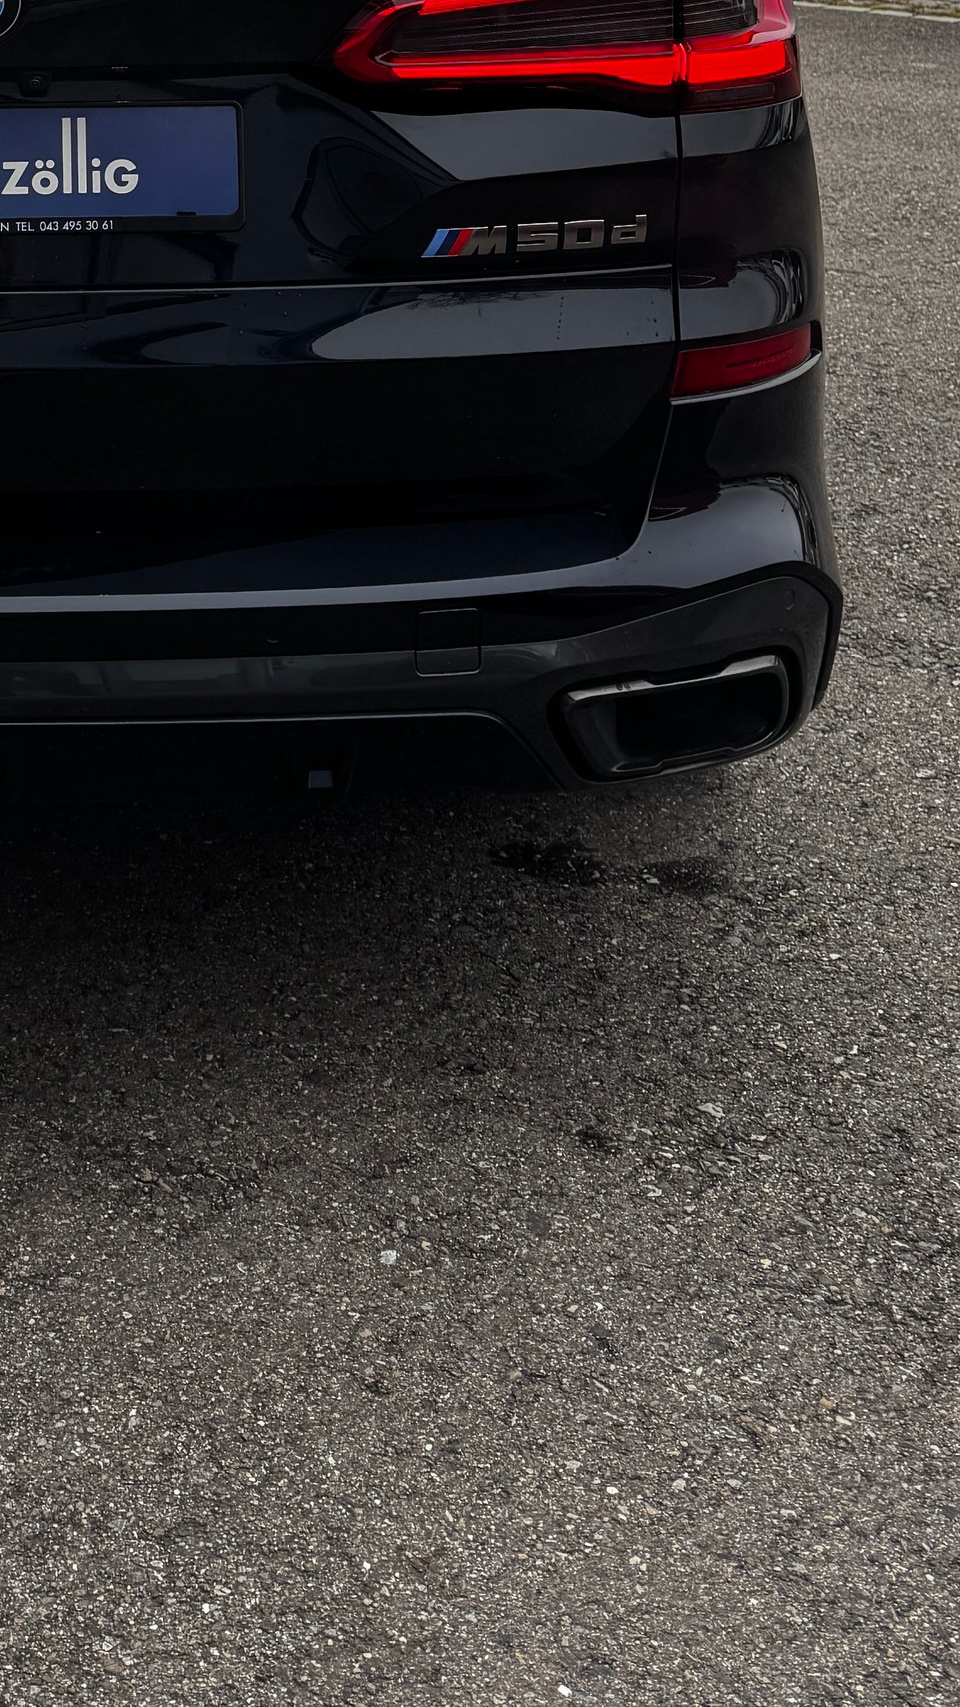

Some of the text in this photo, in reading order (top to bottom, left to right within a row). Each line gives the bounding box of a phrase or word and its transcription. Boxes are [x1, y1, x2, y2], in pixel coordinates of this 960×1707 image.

[15, 221, 35, 232] TEL.
[39, 221, 59, 231] 043
[62, 220, 82, 231] 495
[85, 220, 99, 231] 30
[102, 219, 114, 230] 61
